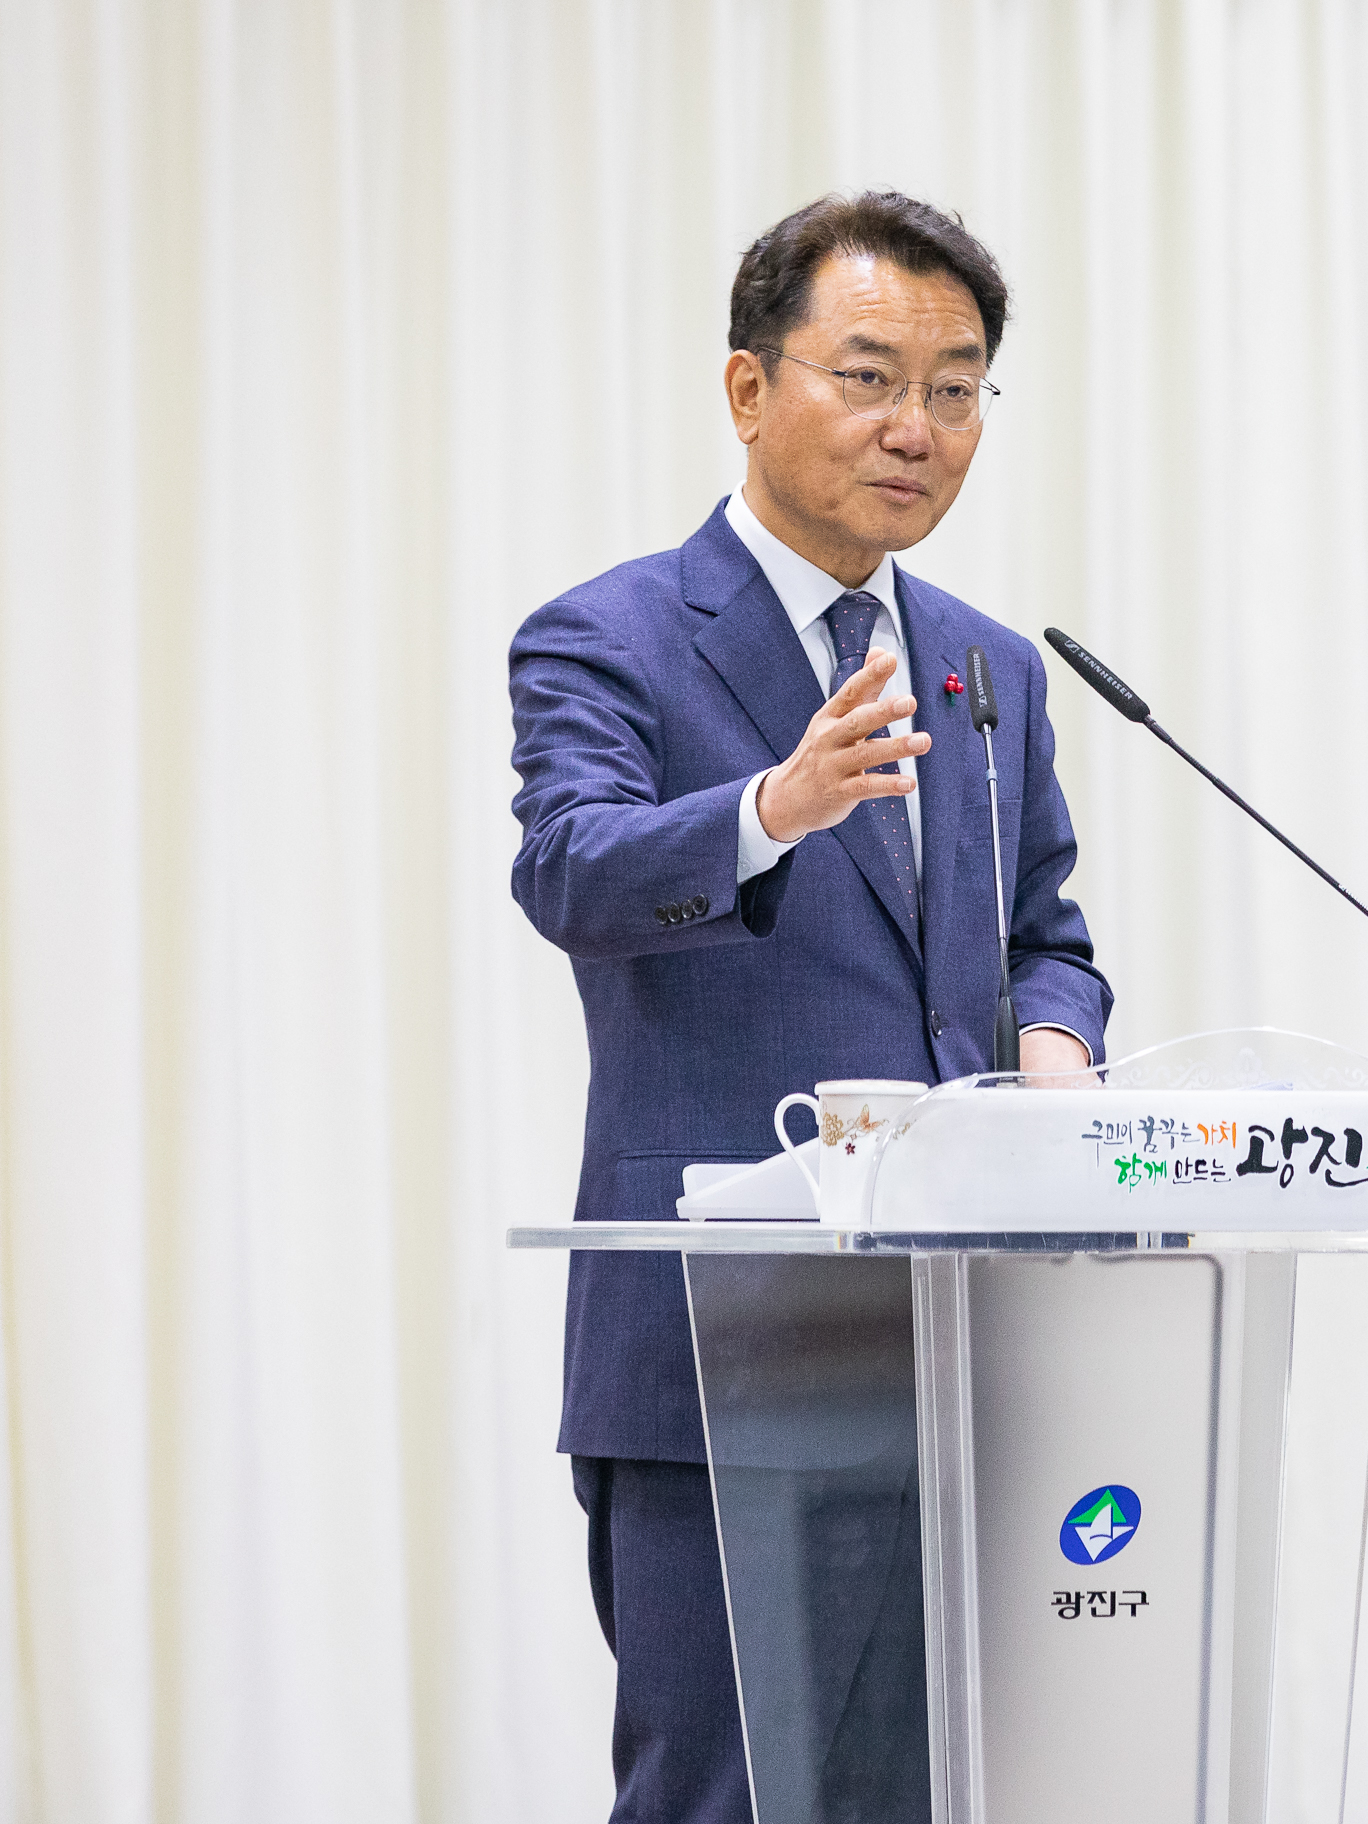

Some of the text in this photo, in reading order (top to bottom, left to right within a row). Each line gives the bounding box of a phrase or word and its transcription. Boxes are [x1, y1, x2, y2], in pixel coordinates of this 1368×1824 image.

[1078, 651, 1133, 700] SENNHEISER
[1197, 1120, 1238, 1149] 가치
[1114, 1152, 1232, 1194] 함께 만드는
[1050, 1590, 1150, 1620] 광진구
